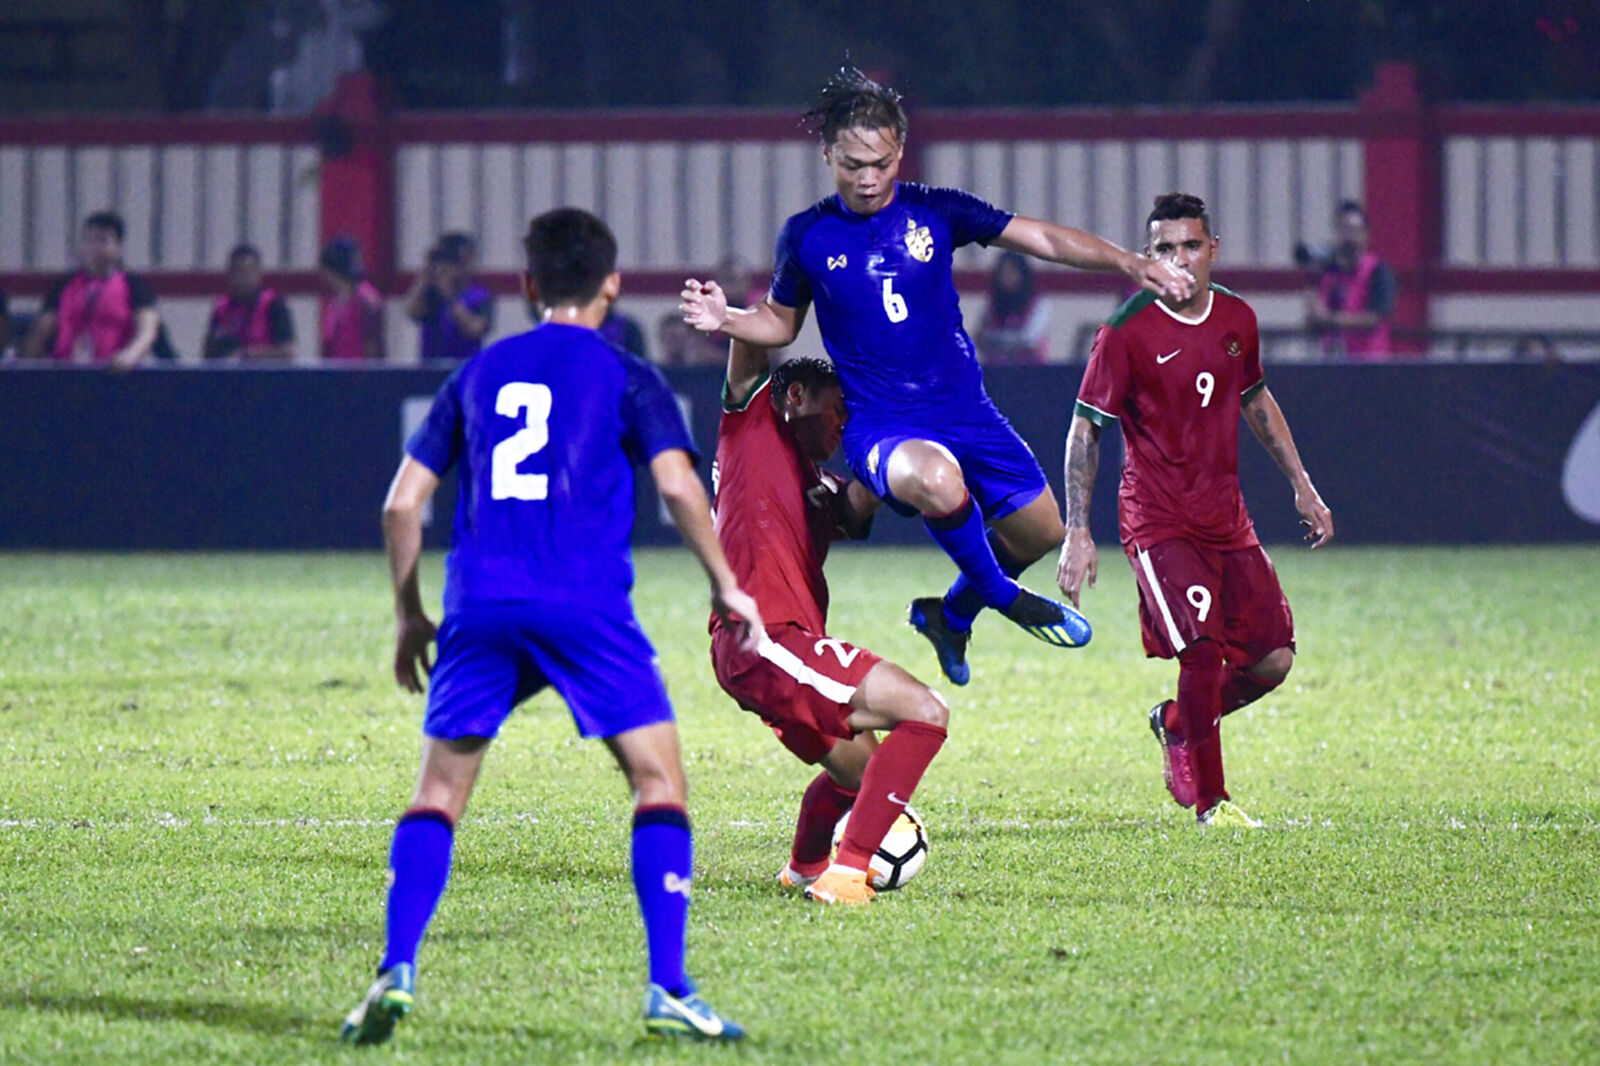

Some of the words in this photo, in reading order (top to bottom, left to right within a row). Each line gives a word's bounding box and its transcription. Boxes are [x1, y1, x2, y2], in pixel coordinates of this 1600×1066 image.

[882, 277, 909, 324] 6
[1195, 371, 1215, 408] 9
[491, 381, 552, 501] 2
[1186, 584, 1212, 623] 9
[813, 638, 861, 669] 2
